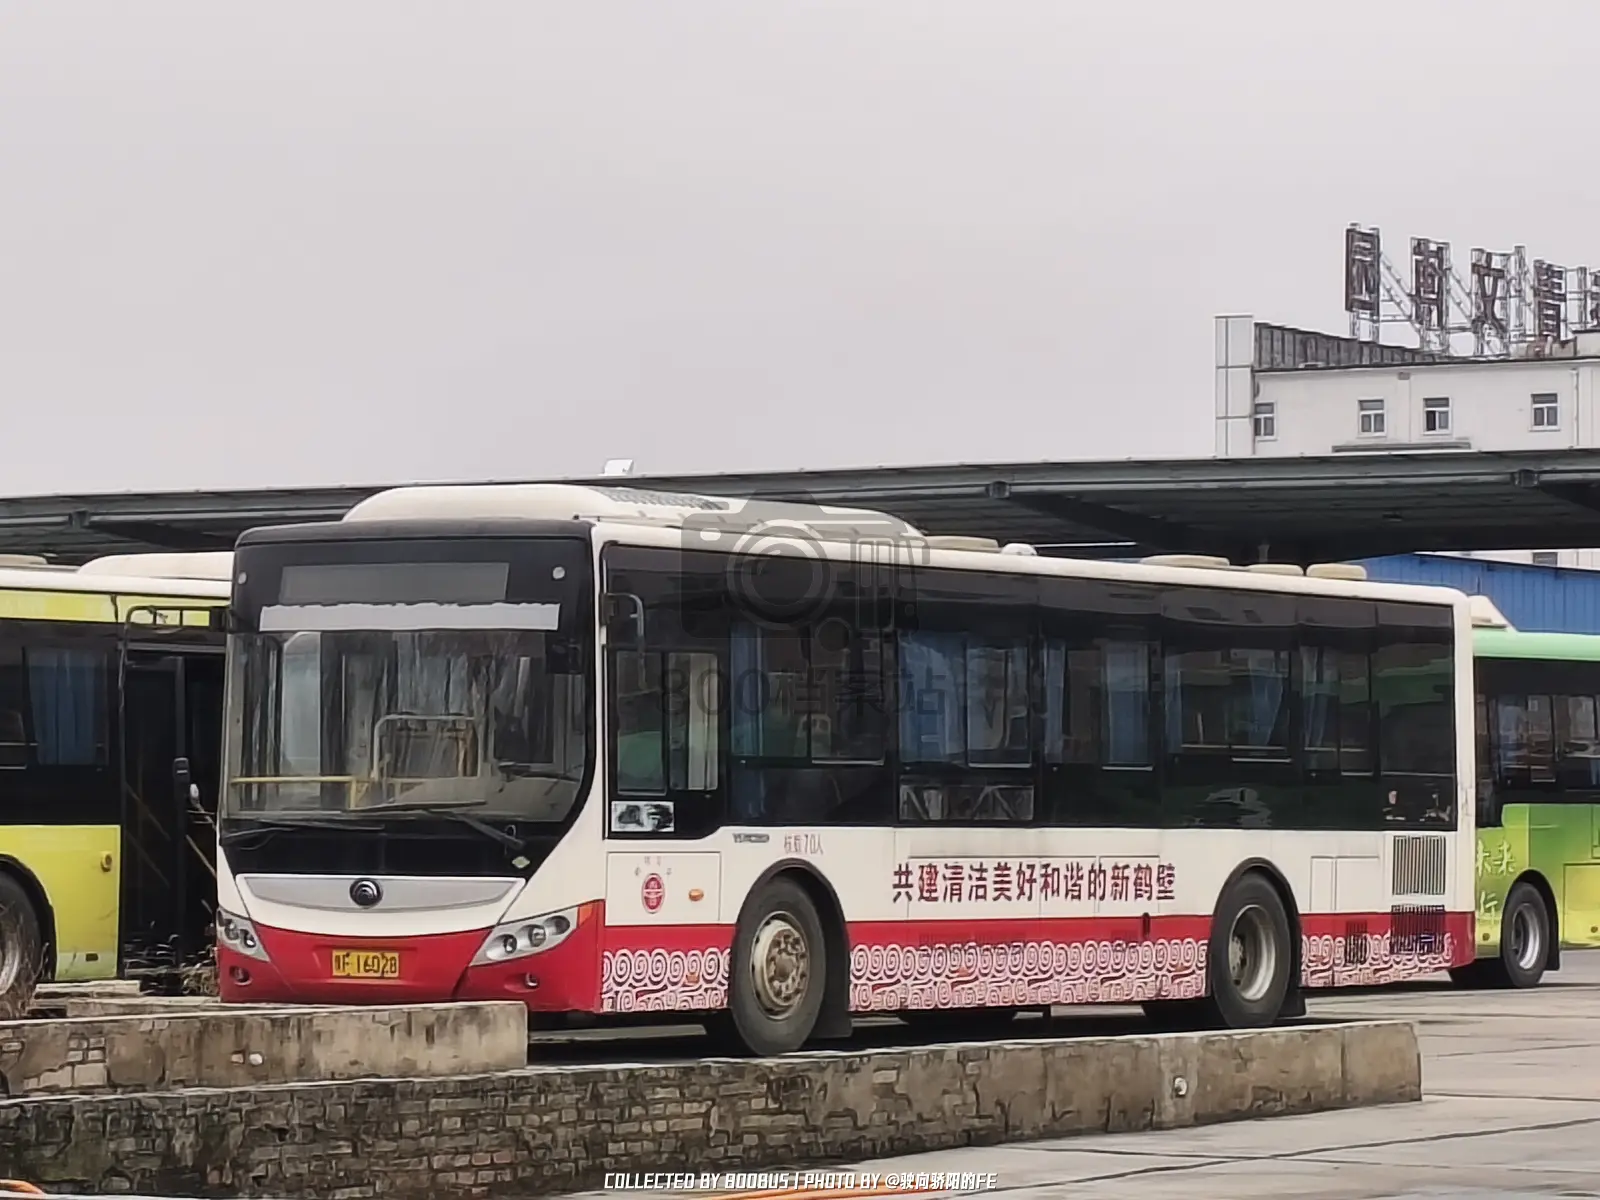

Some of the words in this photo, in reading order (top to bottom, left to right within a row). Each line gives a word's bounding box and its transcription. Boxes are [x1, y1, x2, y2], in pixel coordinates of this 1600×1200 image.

[892, 861, 1176, 903] 共建清洁美好和谐的新鹤壁
